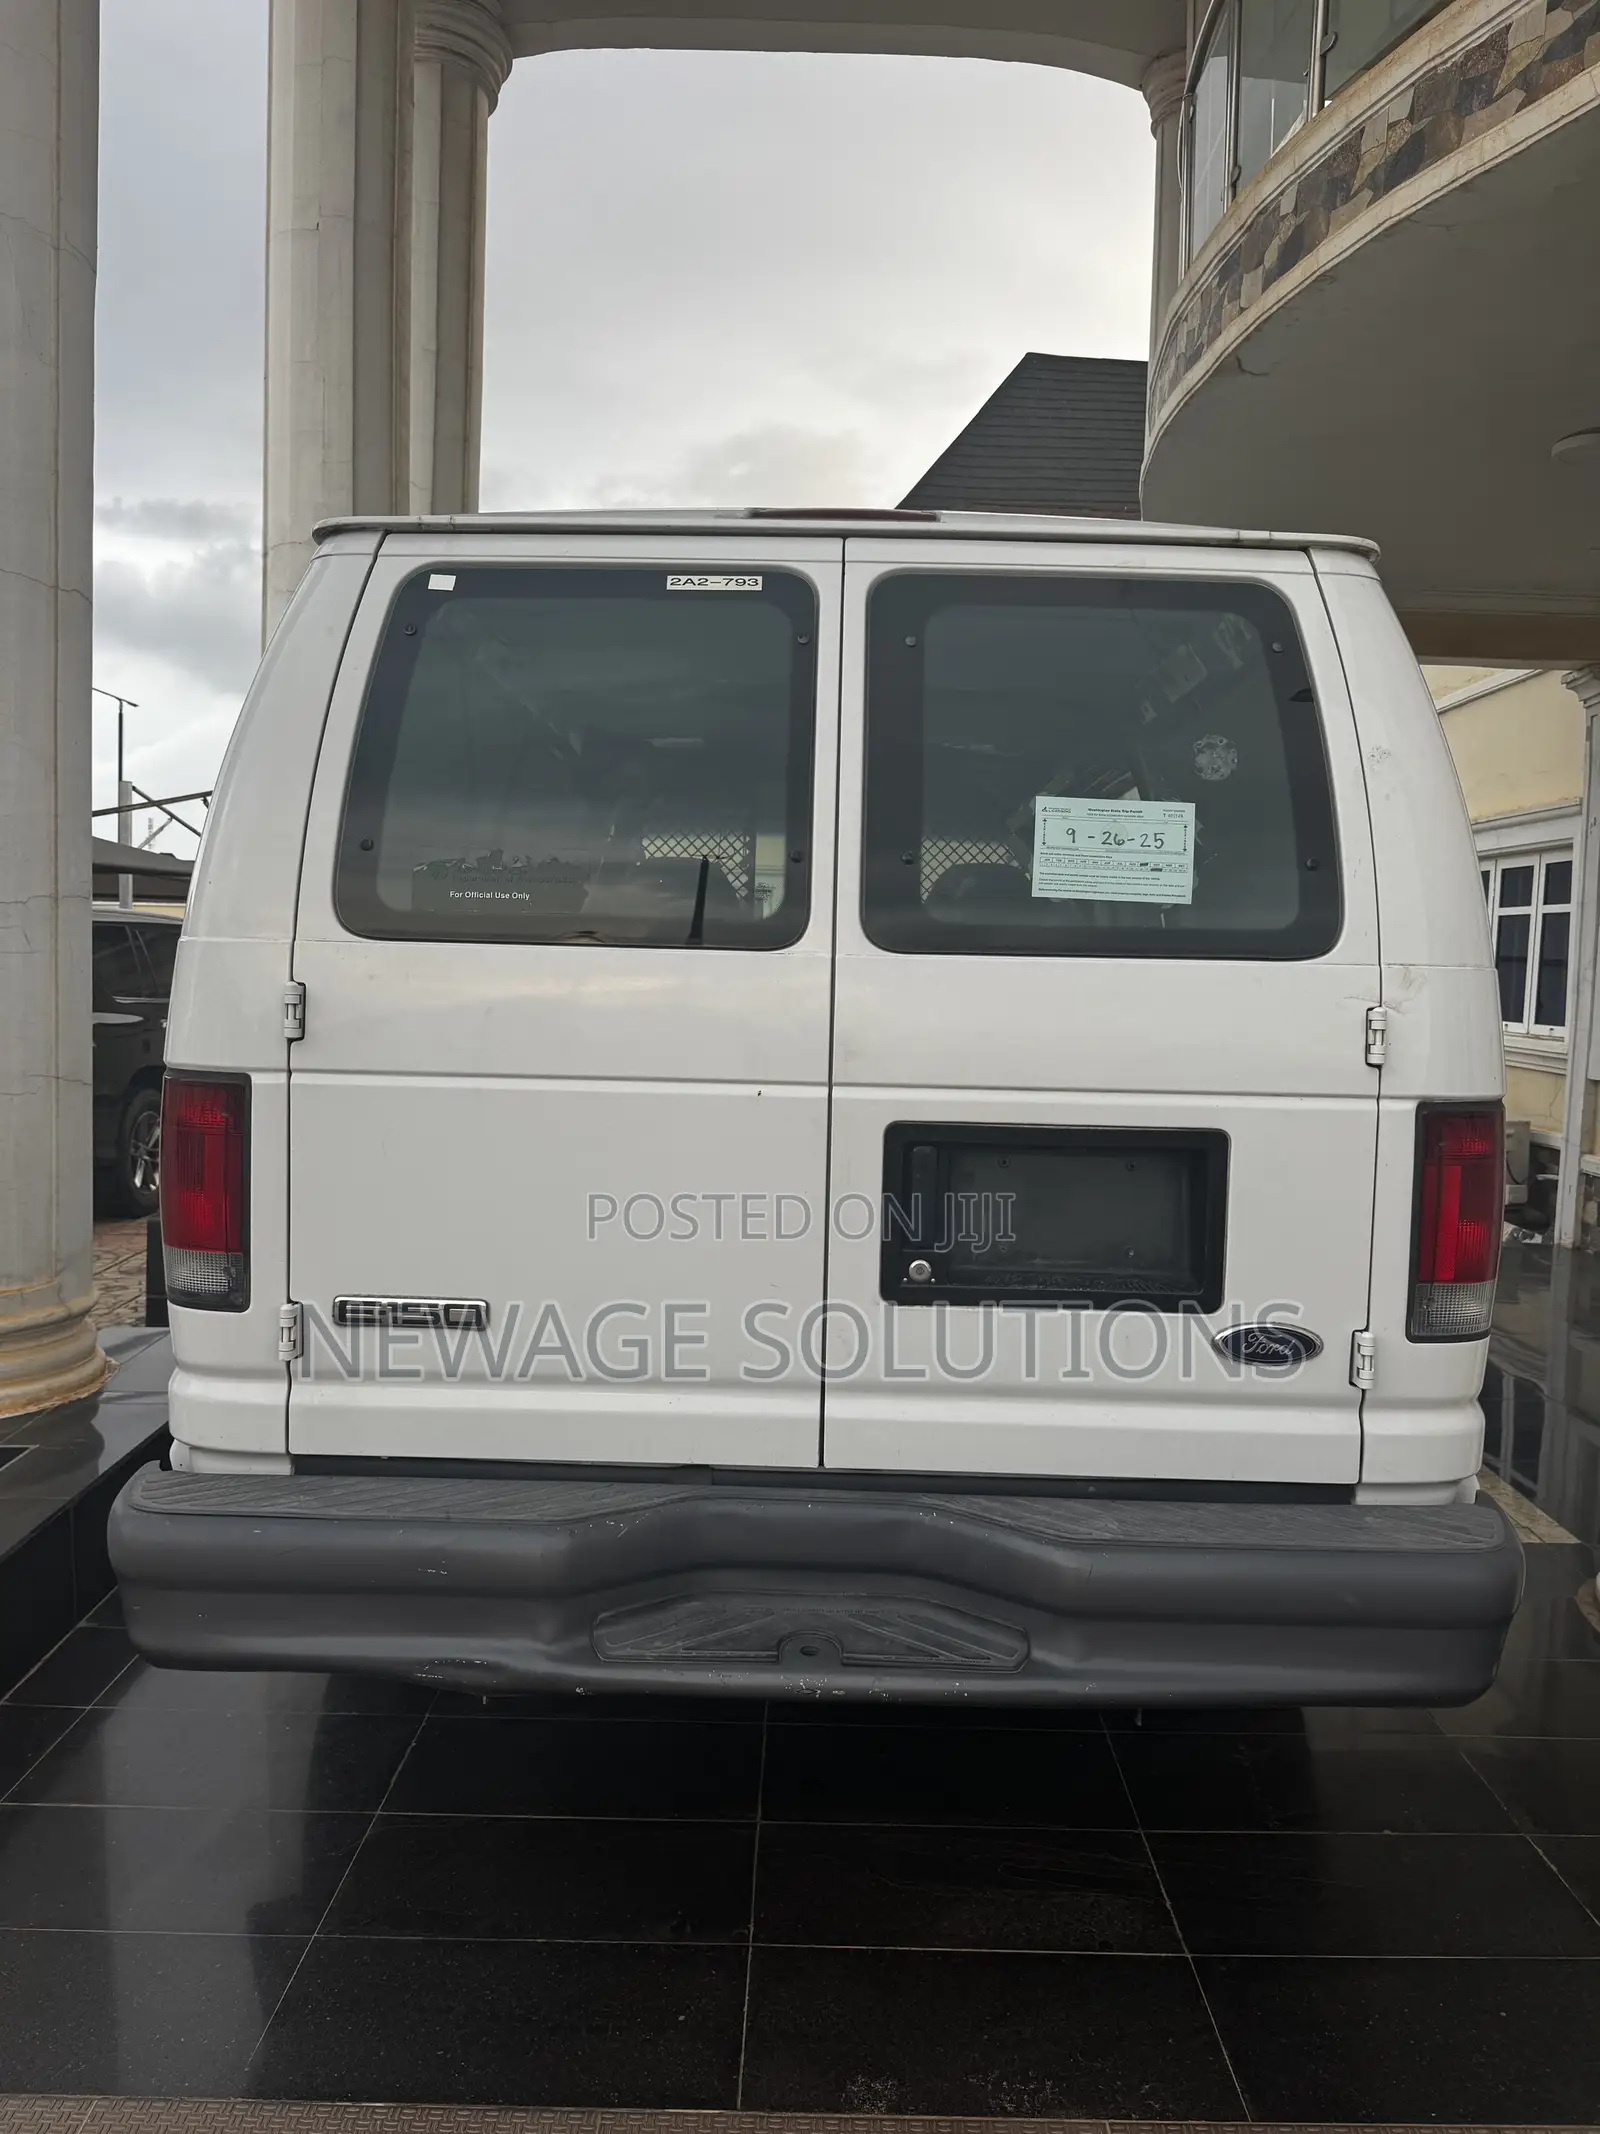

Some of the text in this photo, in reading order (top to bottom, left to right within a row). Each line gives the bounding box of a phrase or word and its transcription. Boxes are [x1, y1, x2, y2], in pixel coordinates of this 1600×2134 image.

[669, 577, 759, 587] 2A2-793
[449, 890, 530, 900] For Official Use Only
[1242, 1332, 1294, 1355] Ford
